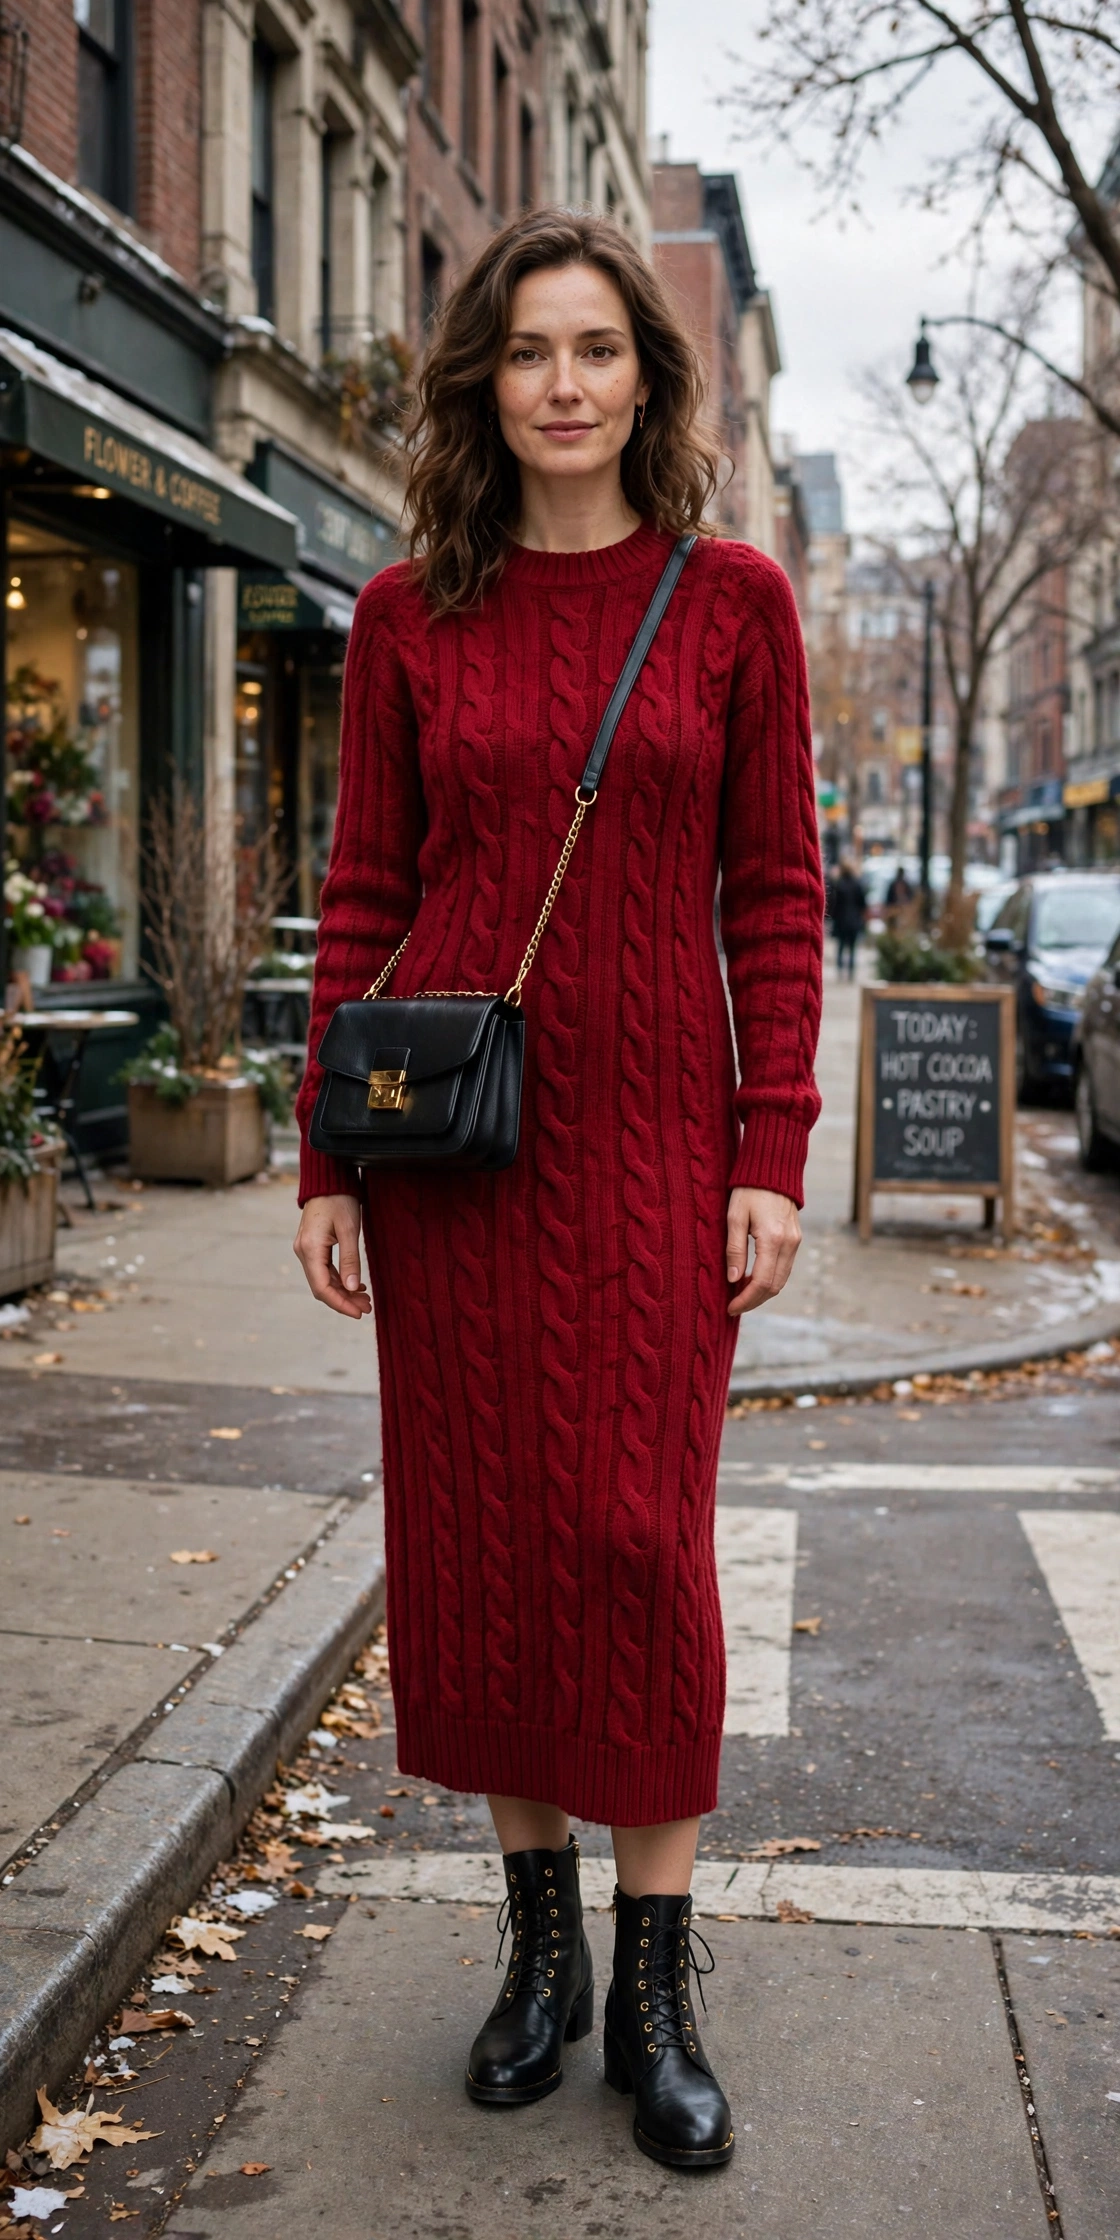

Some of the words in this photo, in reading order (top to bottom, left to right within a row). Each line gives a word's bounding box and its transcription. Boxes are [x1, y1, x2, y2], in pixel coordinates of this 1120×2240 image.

[83, 426, 150, 491] FLOWER
[154, 465, 167, 498] &
[169, 472, 222, 526] COFFEE
[890, 1010, 978, 1044] TODAY:
[881, 1051, 924, 1082] HOT
[926, 1052, 993, 1083] COCOA
[896, 1088, 977, 1121] PASTRY
[903, 1123, 965, 1157] SOUP
